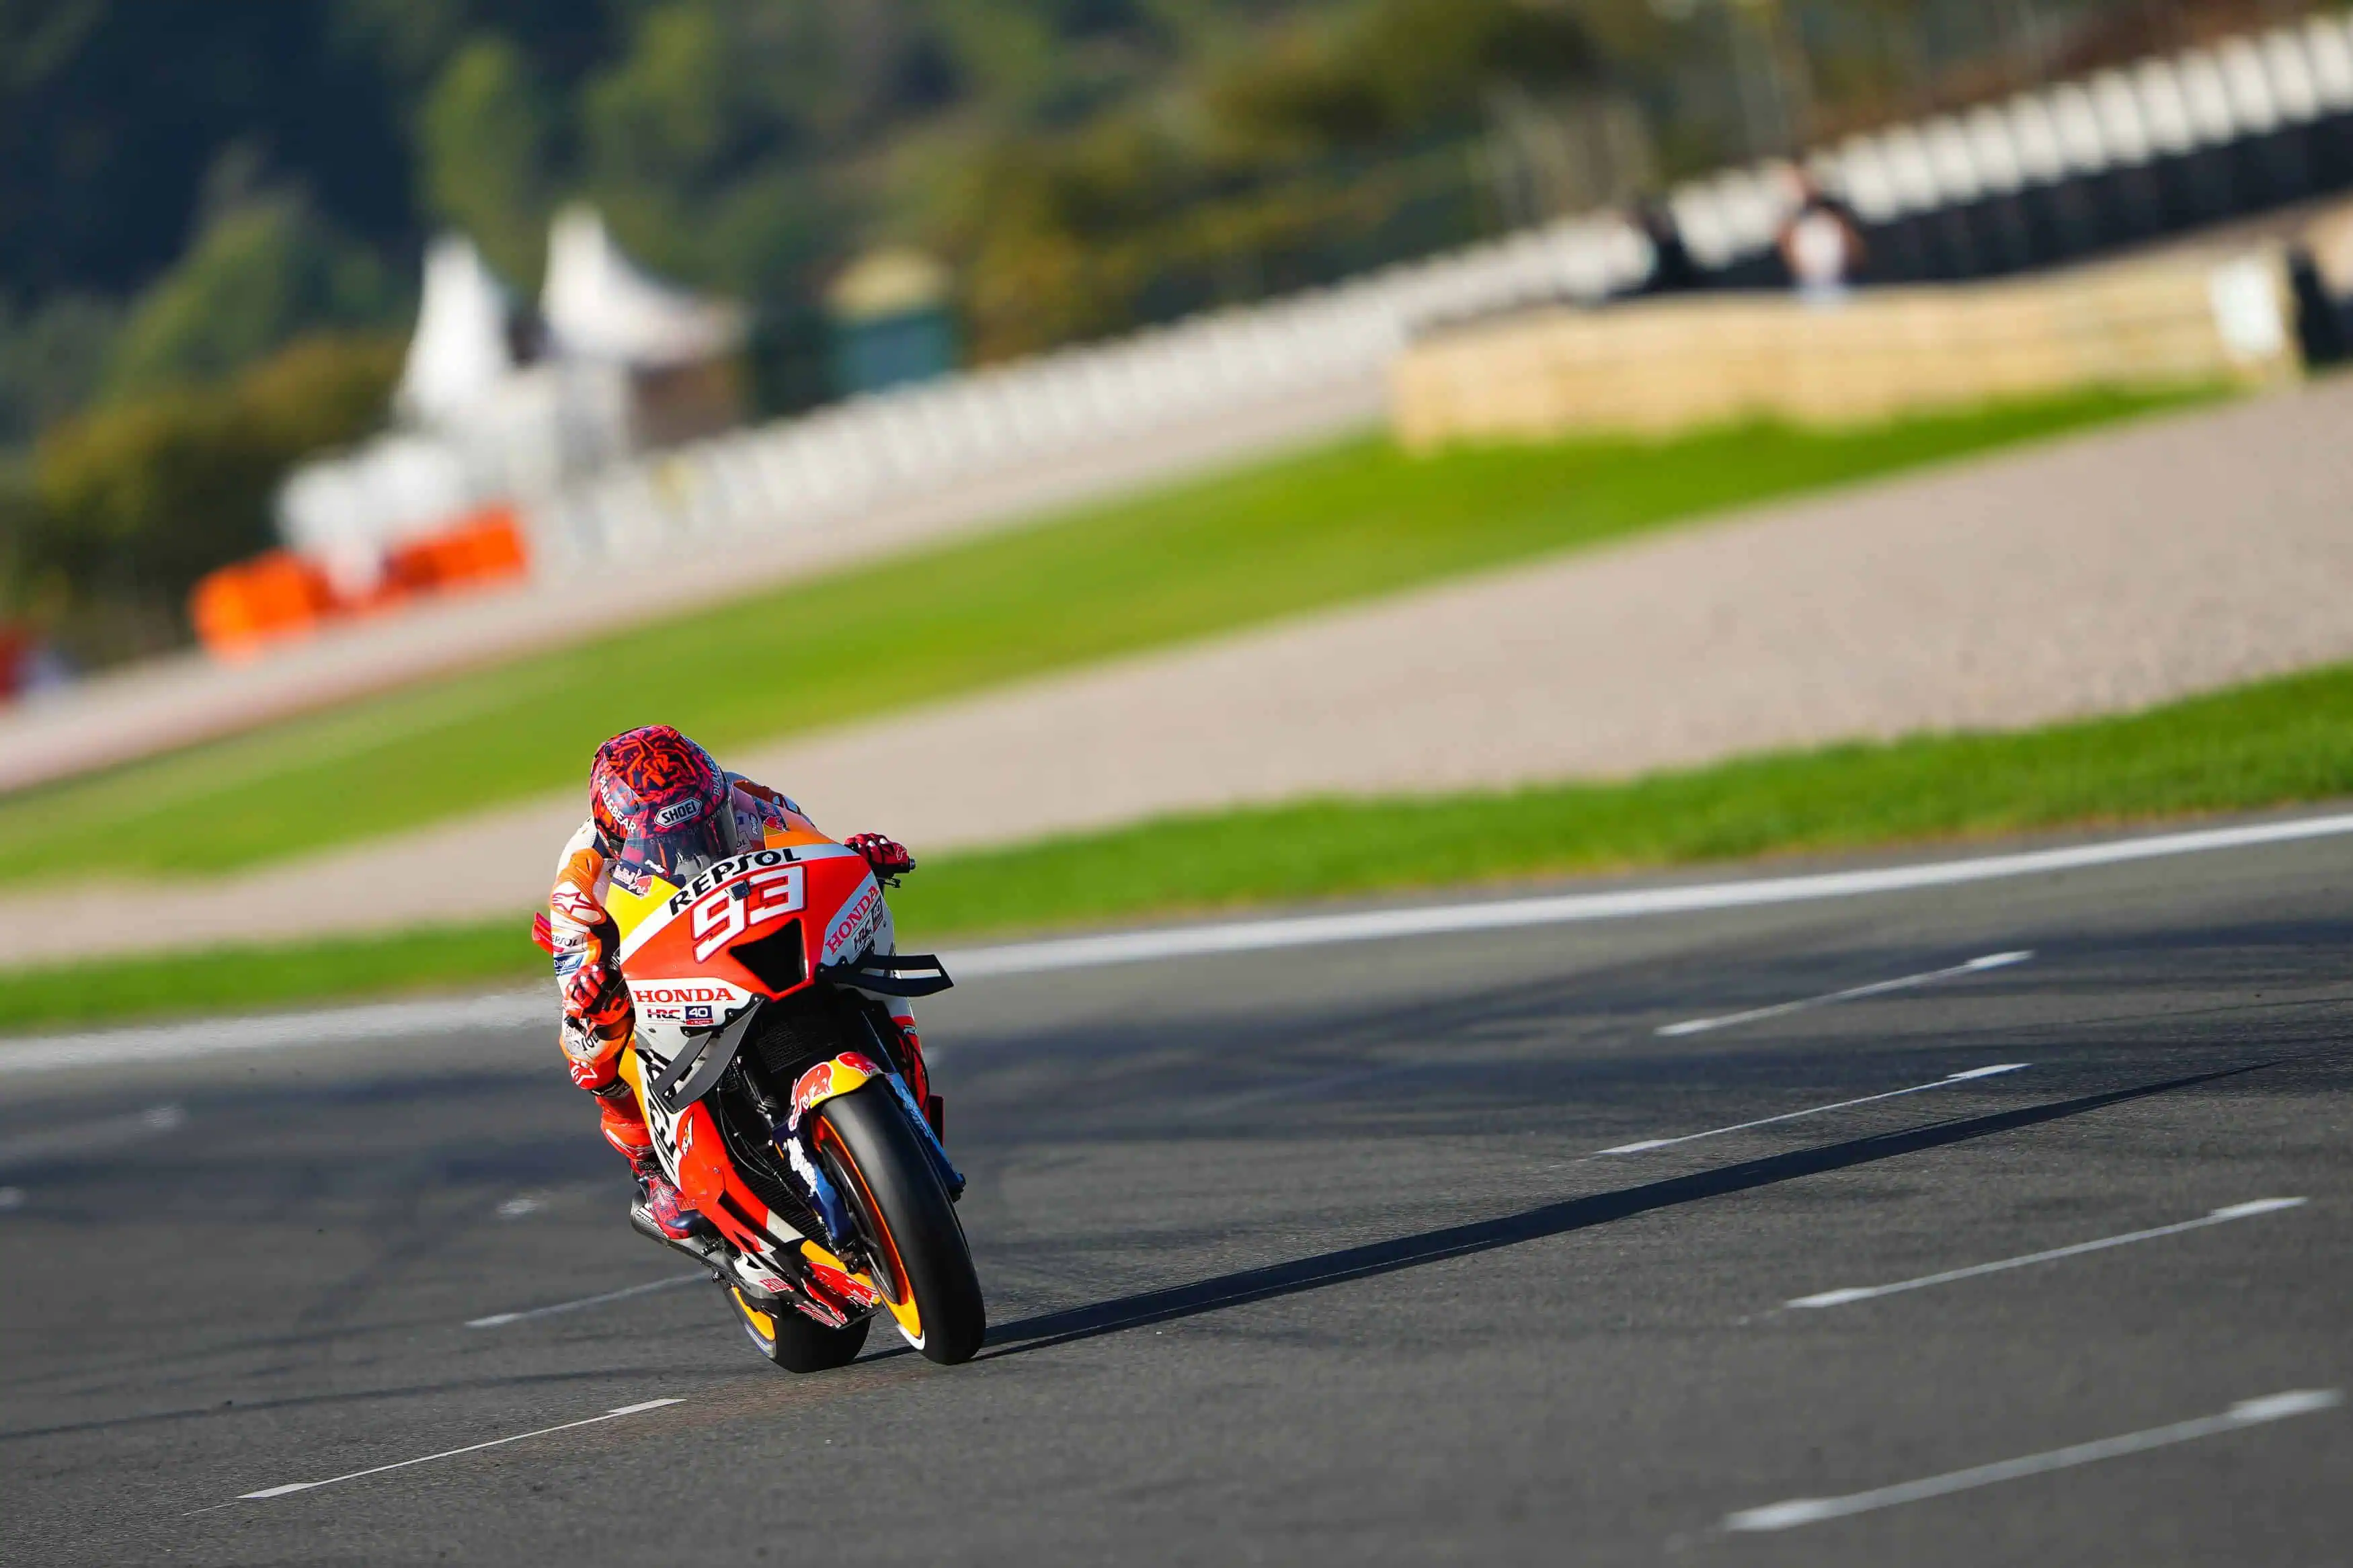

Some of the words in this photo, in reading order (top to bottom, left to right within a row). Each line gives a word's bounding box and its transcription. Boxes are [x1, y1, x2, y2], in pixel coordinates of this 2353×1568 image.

[599, 775, 637, 834] PULL&BEAR
[661, 800, 697, 824] SHOEI
[669, 848, 801, 915] REPSOL
[690, 863, 809, 964] 93
[825, 885, 879, 955] HONDA
[551, 934, 579, 947] EPSOL
[633, 988, 736, 1003] HONDA
[647, 1009, 680, 1019] HRC
[688, 1007, 709, 1018] 40
